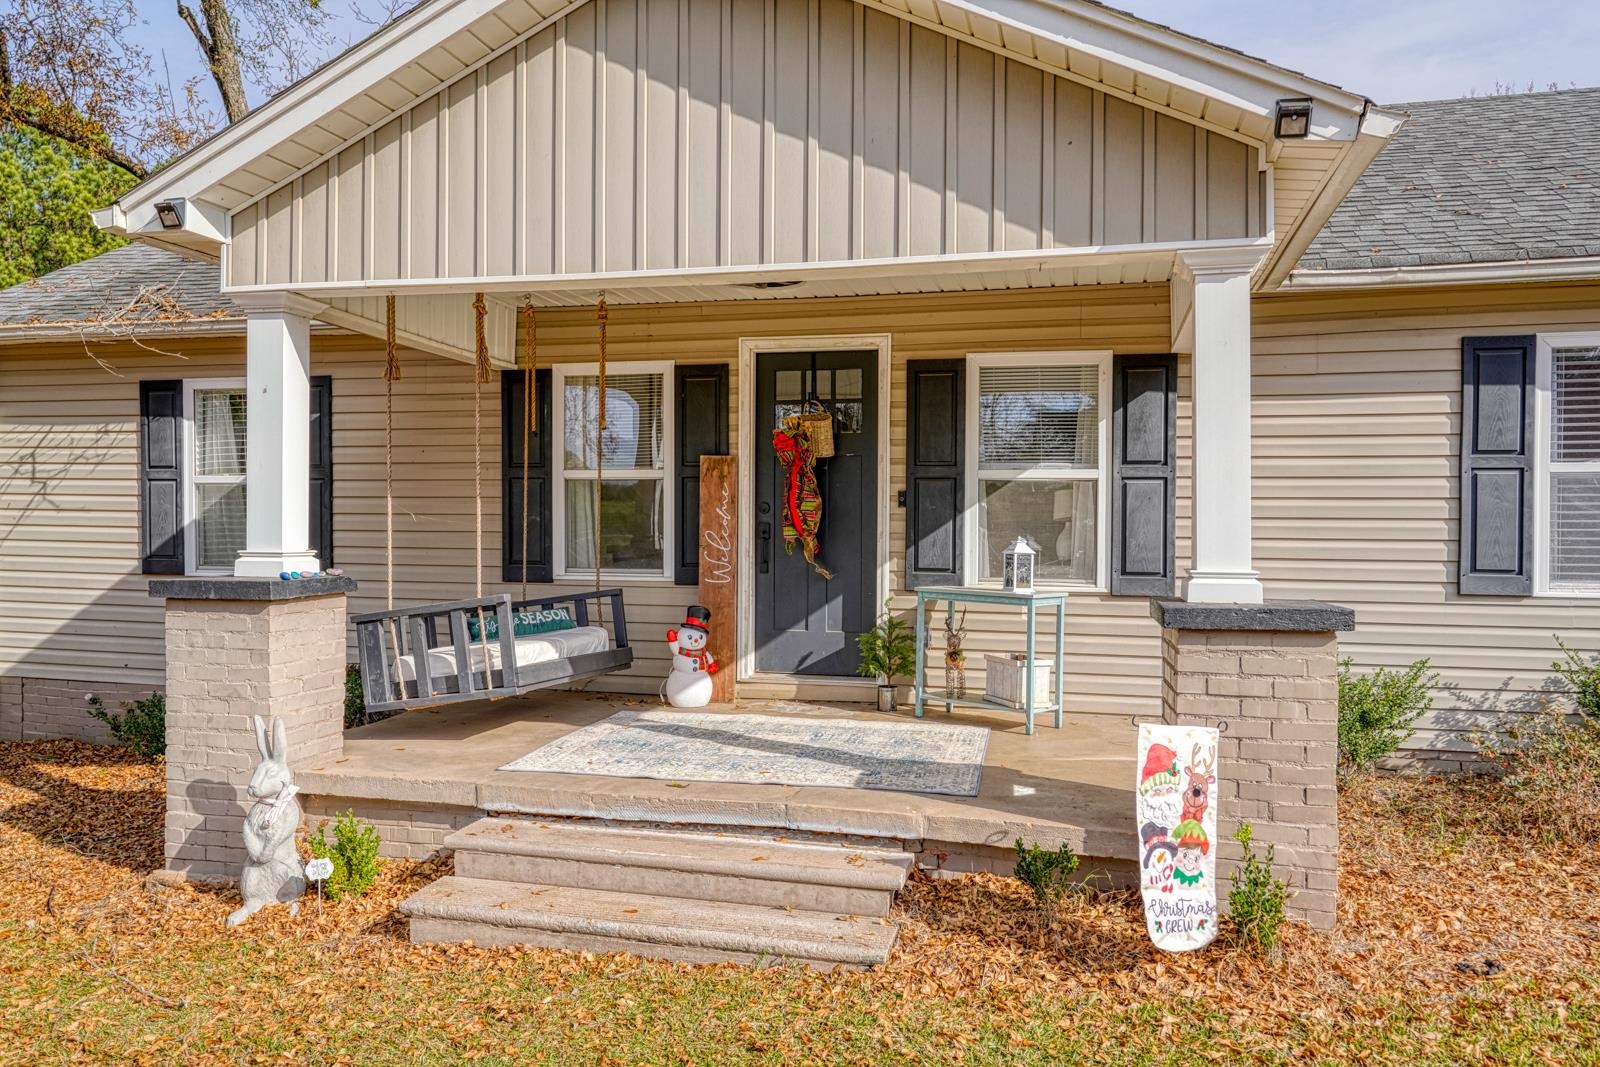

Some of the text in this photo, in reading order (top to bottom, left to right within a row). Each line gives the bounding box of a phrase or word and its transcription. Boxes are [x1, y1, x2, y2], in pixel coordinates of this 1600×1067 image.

[704, 482, 731, 582] Welcome
[520, 608, 570, 625] SEASON
[1148, 897, 1216, 918] Christmas
[1165, 919, 1194, 934] CREW
